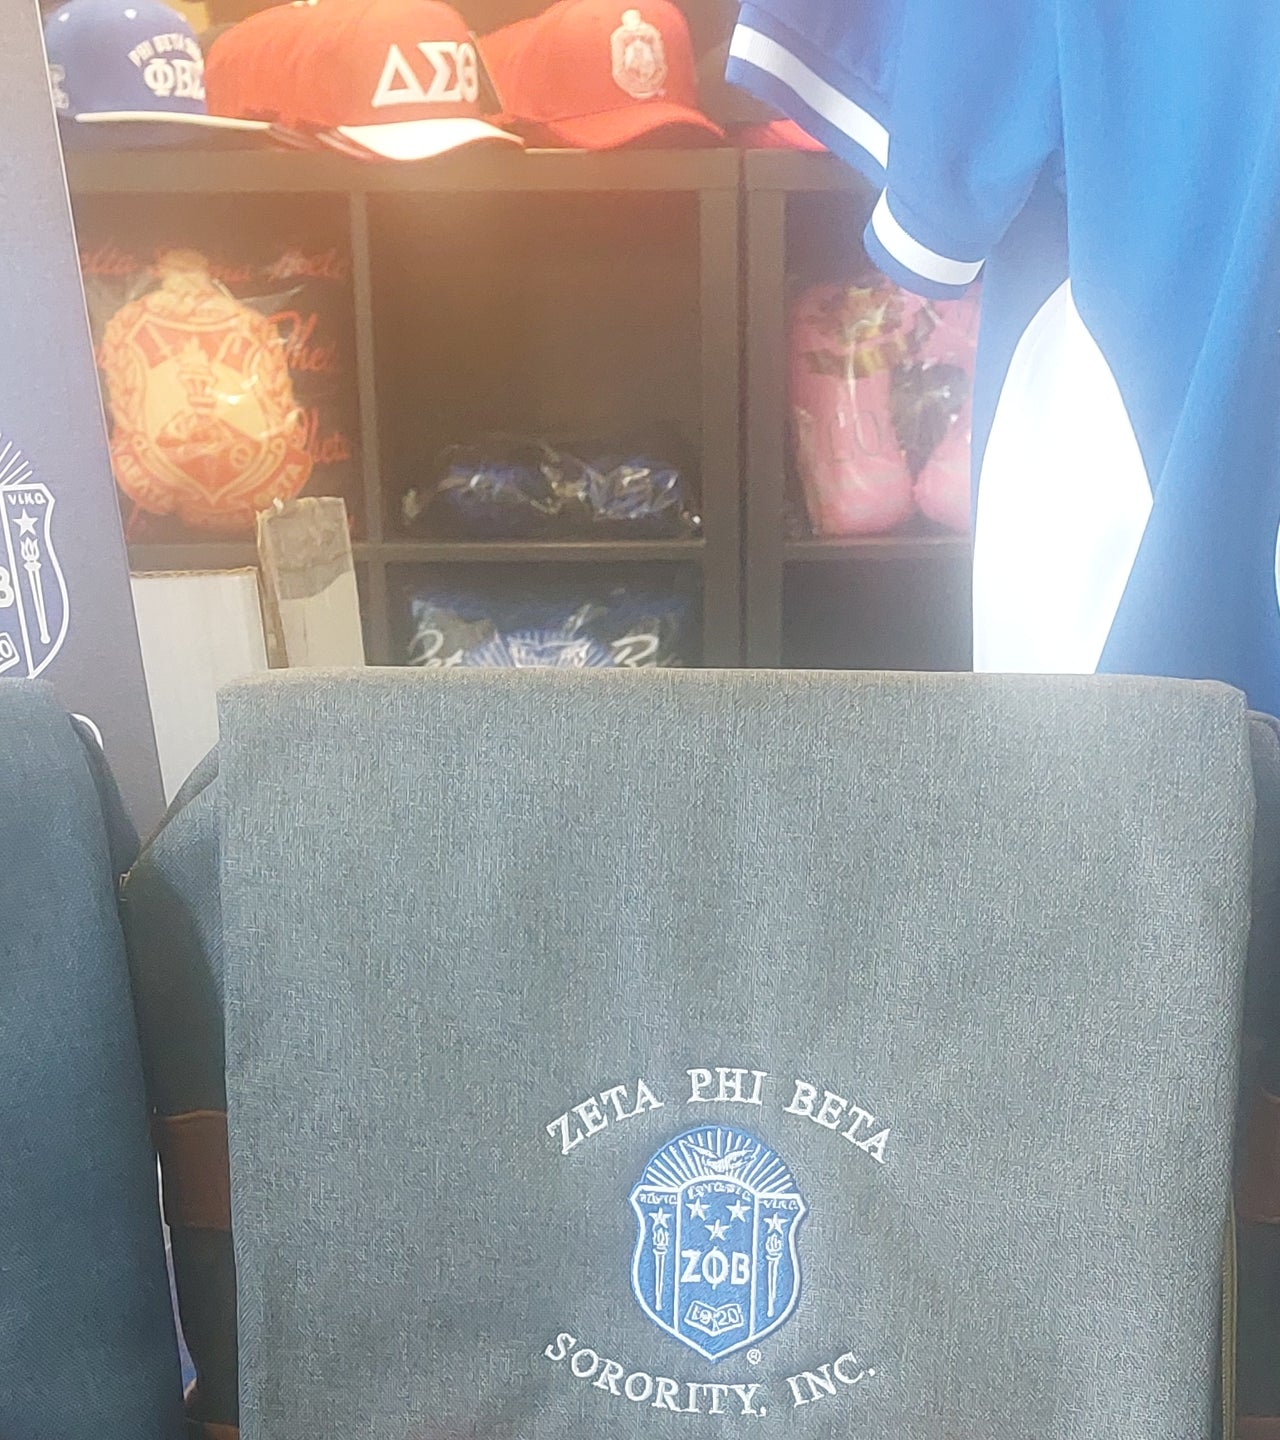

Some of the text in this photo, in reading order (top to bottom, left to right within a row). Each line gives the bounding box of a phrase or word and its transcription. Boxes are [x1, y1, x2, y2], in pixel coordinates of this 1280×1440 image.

[371, 40, 479, 108] ΔΣΘ
[546, 1066, 894, 1165] ZETA PHI BETA
[545, 1333, 877, 1417] SORORITY, INC.
